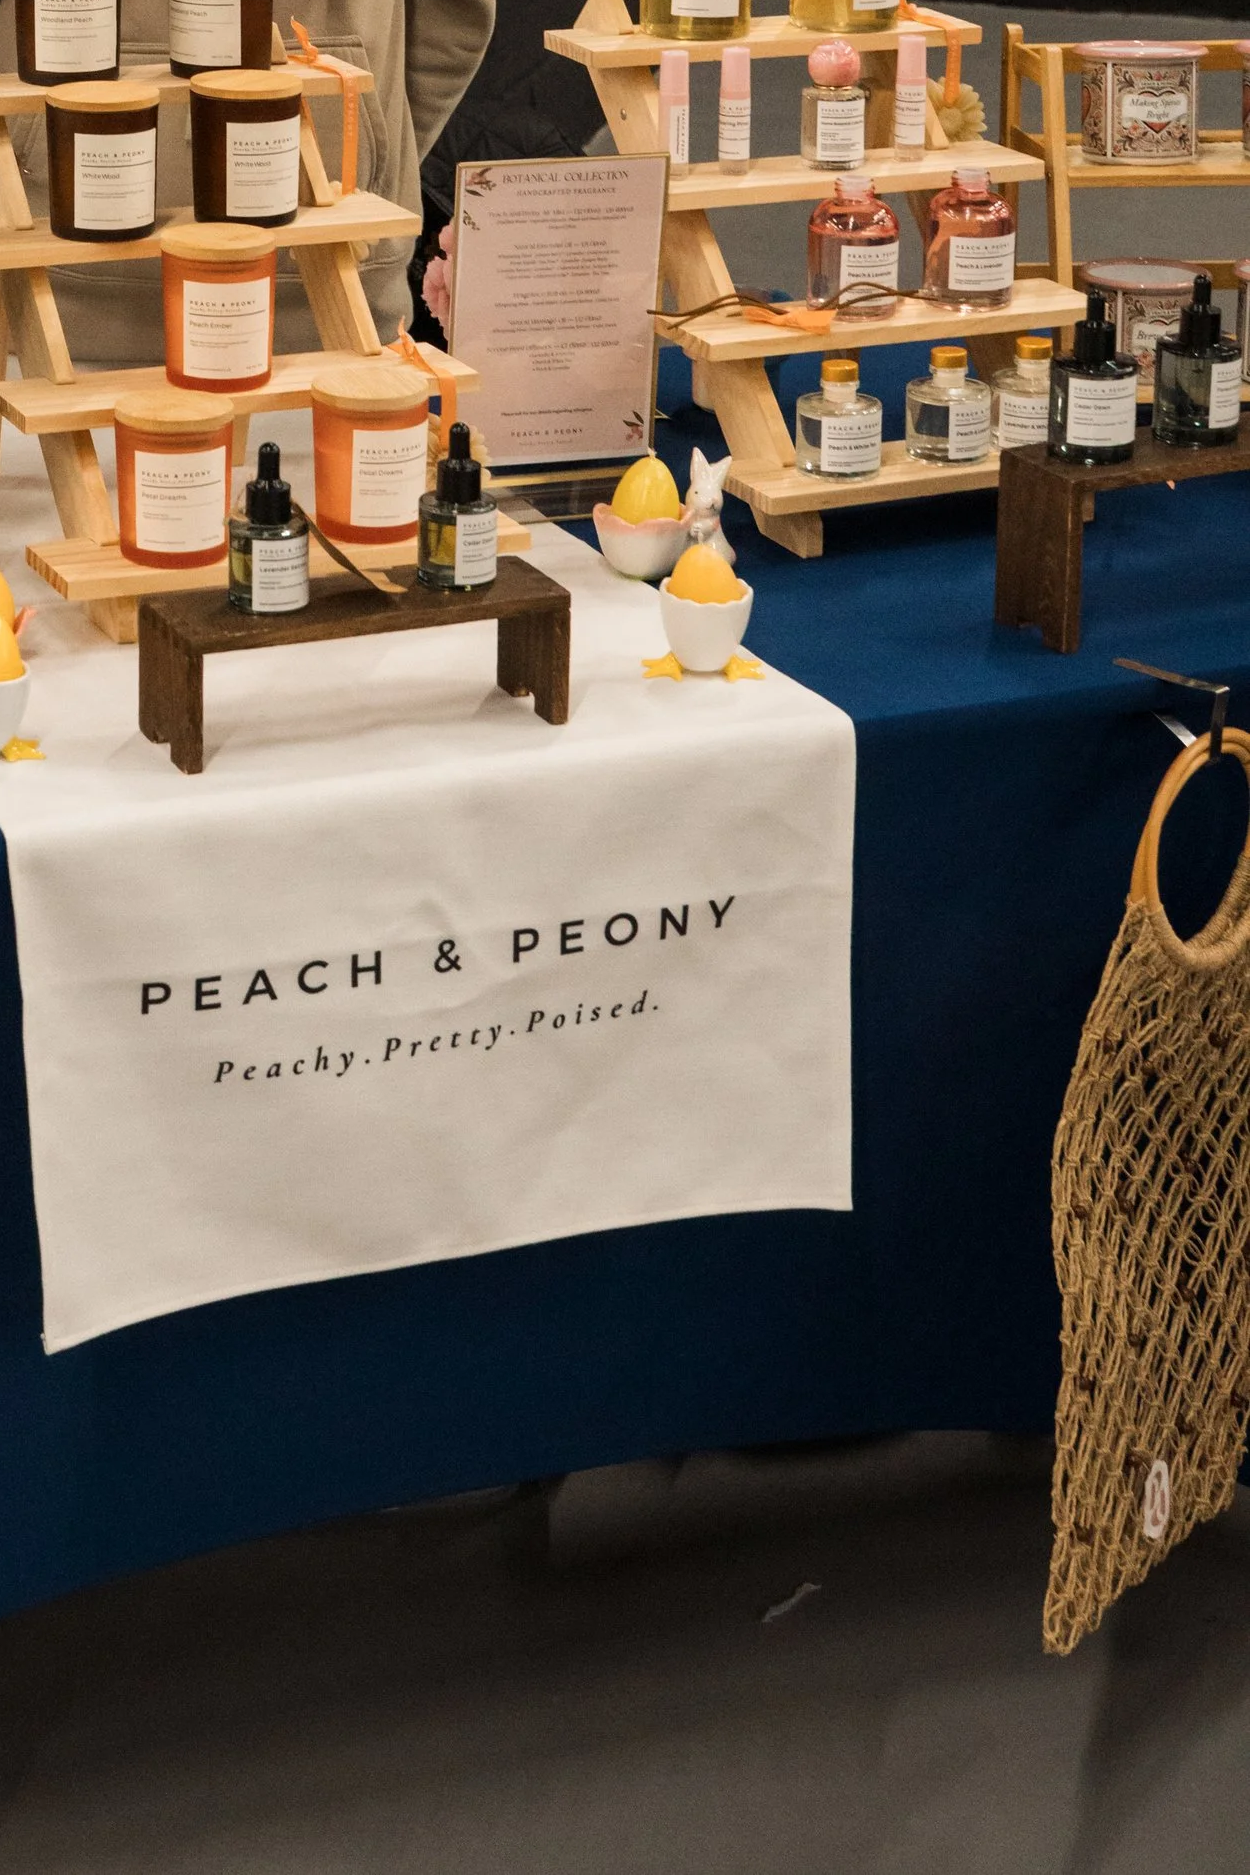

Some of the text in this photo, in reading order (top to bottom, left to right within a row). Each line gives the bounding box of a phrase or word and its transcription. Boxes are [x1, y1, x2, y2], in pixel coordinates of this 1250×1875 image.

[40, 16, 73, 24] Woodland
[1130, 97, 1159, 109] Making
[1146, 109, 1170, 121] Bright
[233, 160, 272, 168] White Wood
[81, 172, 121, 181] White Wood
[502, 169, 630, 185] BOTANICAL COLLECTION
[516, 187, 617, 197] HANDCRAFTED FRAGRANCE
[955, 262, 975, 270] Peach
[979, 261, 1004, 270] Lavender
[847, 271, 867, 279] Peach
[189, 320, 233, 330] Peach Ember
[510, 430, 540, 438] PEACH
[553, 427, 583, 435] PEONY
[828, 444, 849, 453] Peach
[358, 468, 404, 477] Petal Dreams
[141, 491, 188, 502] Petal Dreams
[140, 895, 737, 1015] PEACH & PEONY
